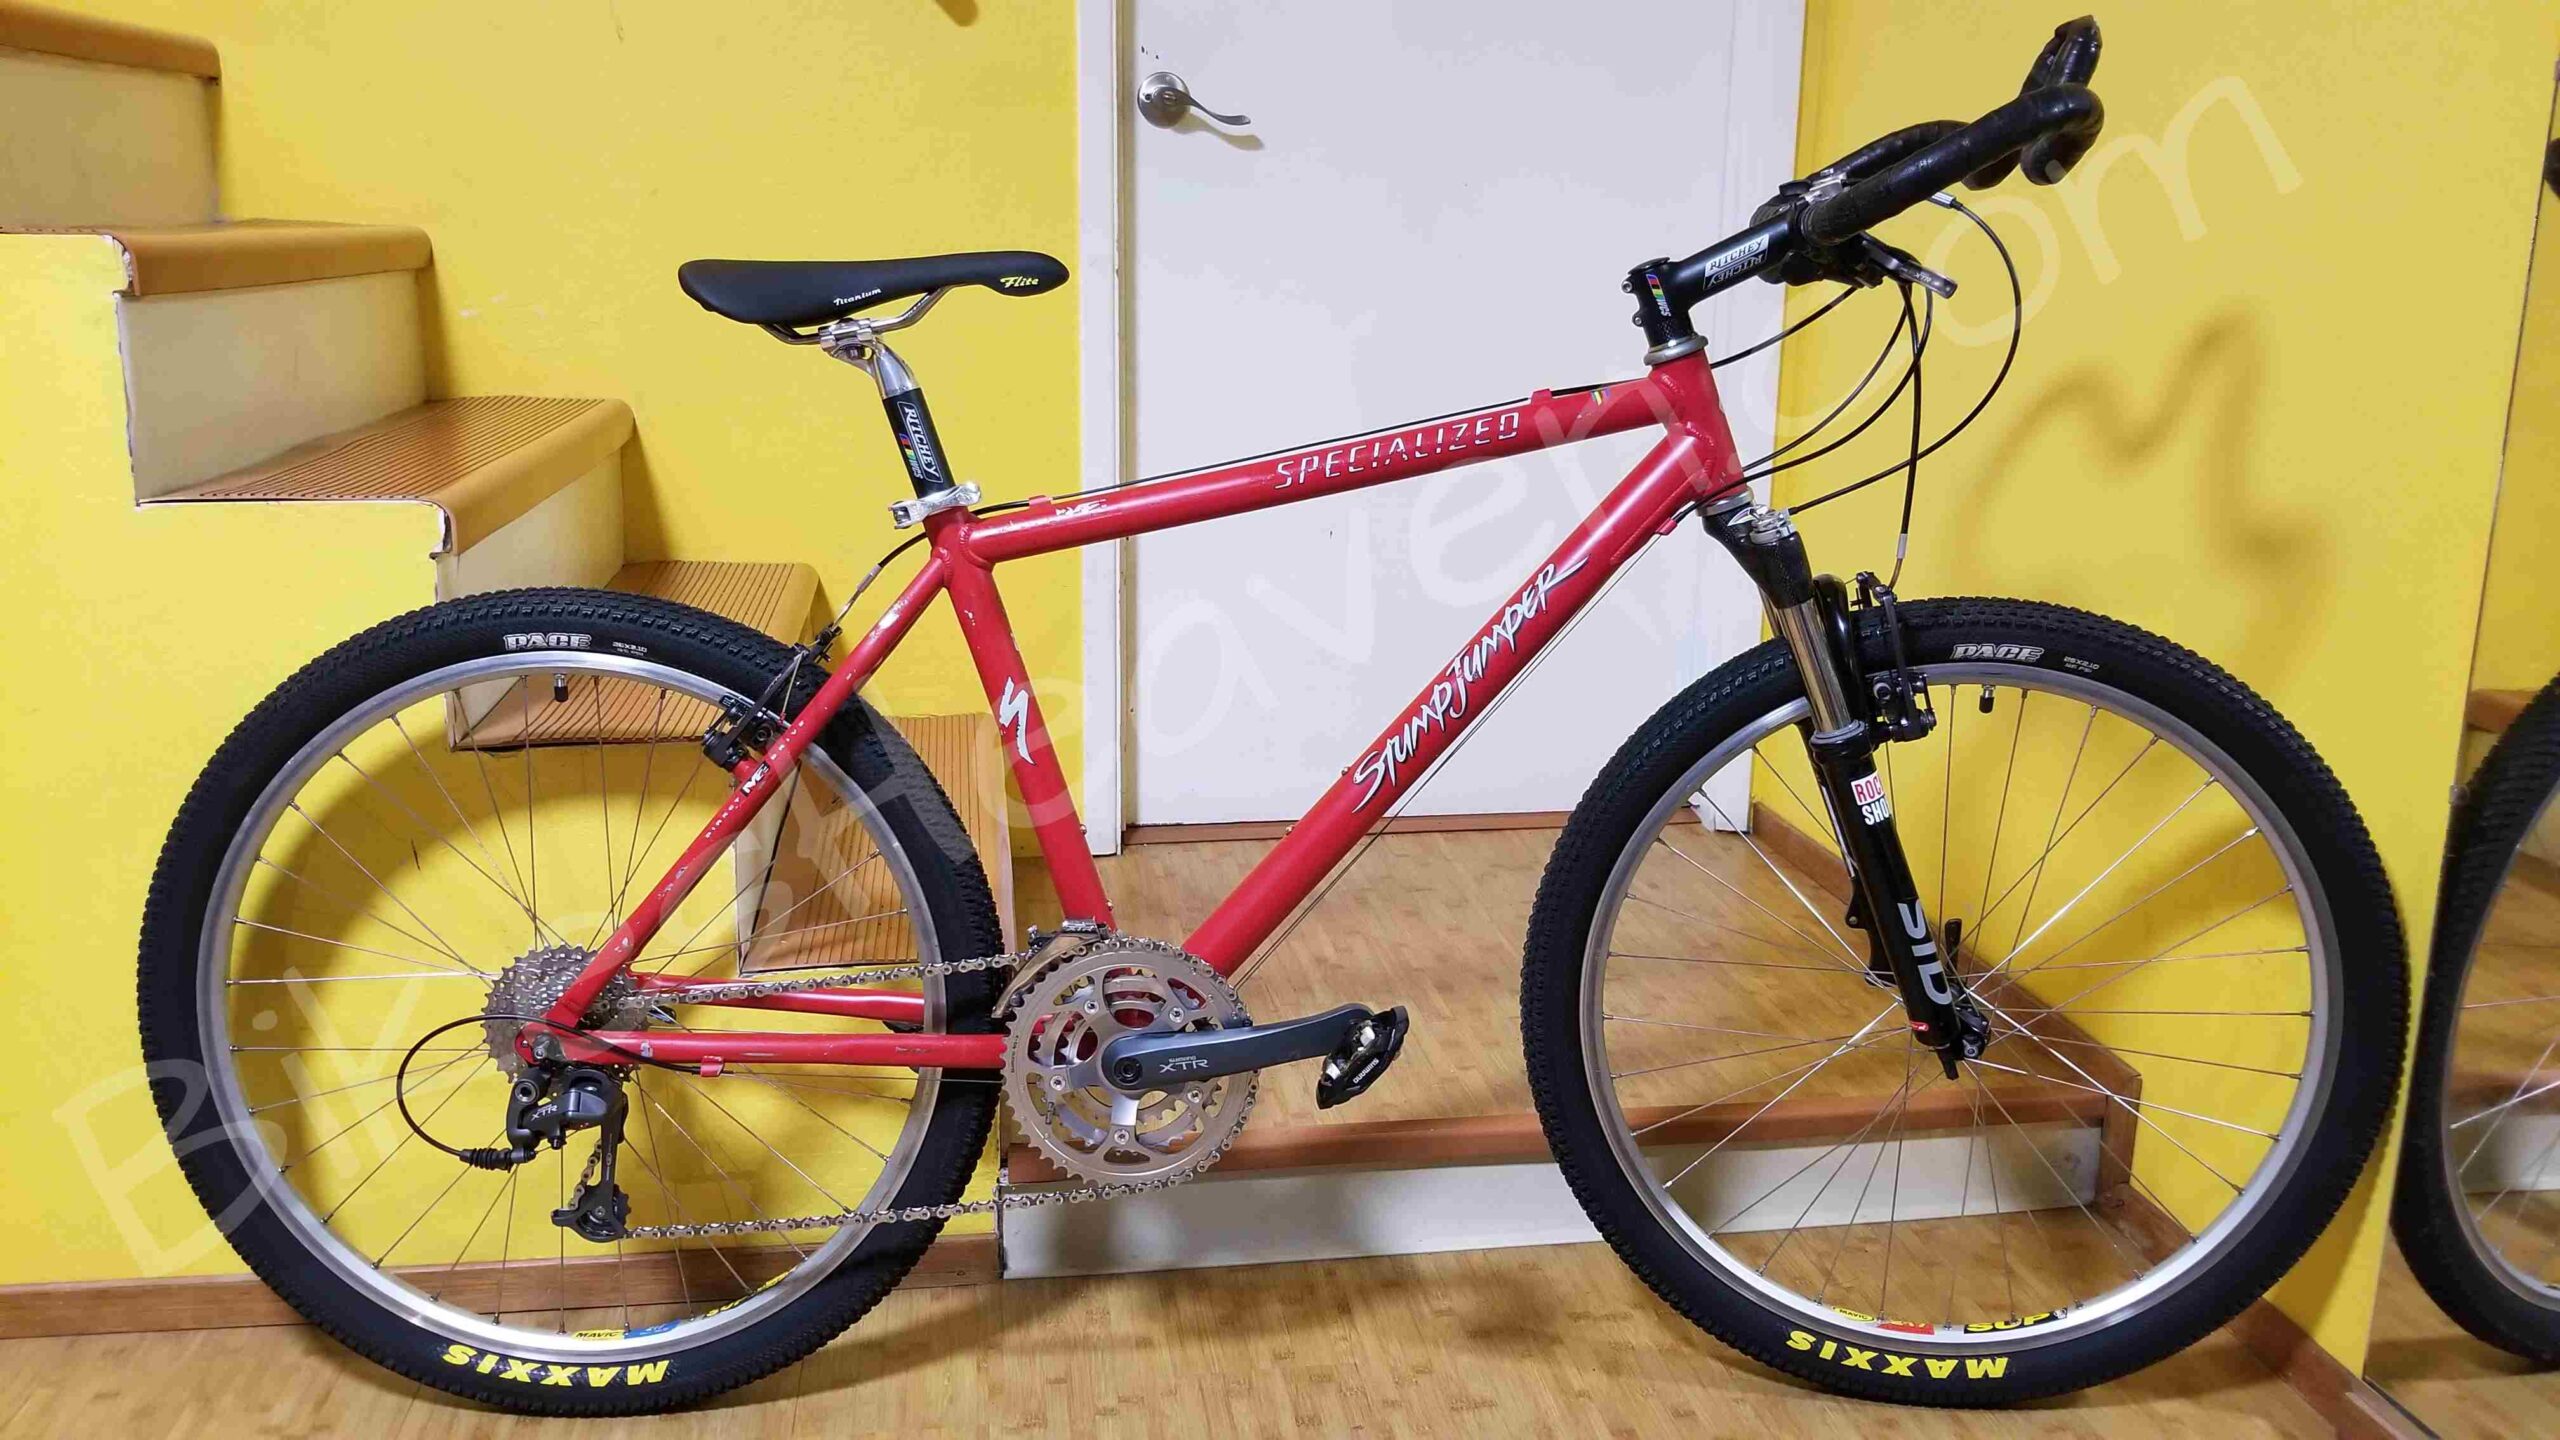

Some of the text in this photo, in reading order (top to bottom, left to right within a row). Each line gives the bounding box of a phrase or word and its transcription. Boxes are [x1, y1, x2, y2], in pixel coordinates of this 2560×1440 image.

[1708, 237, 1765, 272] RITCHEY
[1000, 275, 1040, 289] Flite
[833, 287, 883, 307] Titanium
[902, 406, 941, 479] RITCHEY
[1274, 411, 1521, 490] SPECIALIZED
[503, 632, 593, 650] PACE
[1951, 643, 2045, 663] PACE
[1854, 775, 1884, 803] ROC
[1861, 797, 1890, 825] SHO
[1159, 1059, 1209, 1073] XTR
[530, 1103, 558, 1121] XTR
[441, 1343, 670, 1389] MAXXIS
[1785, 1329, 2009, 1380] MAXXIS
